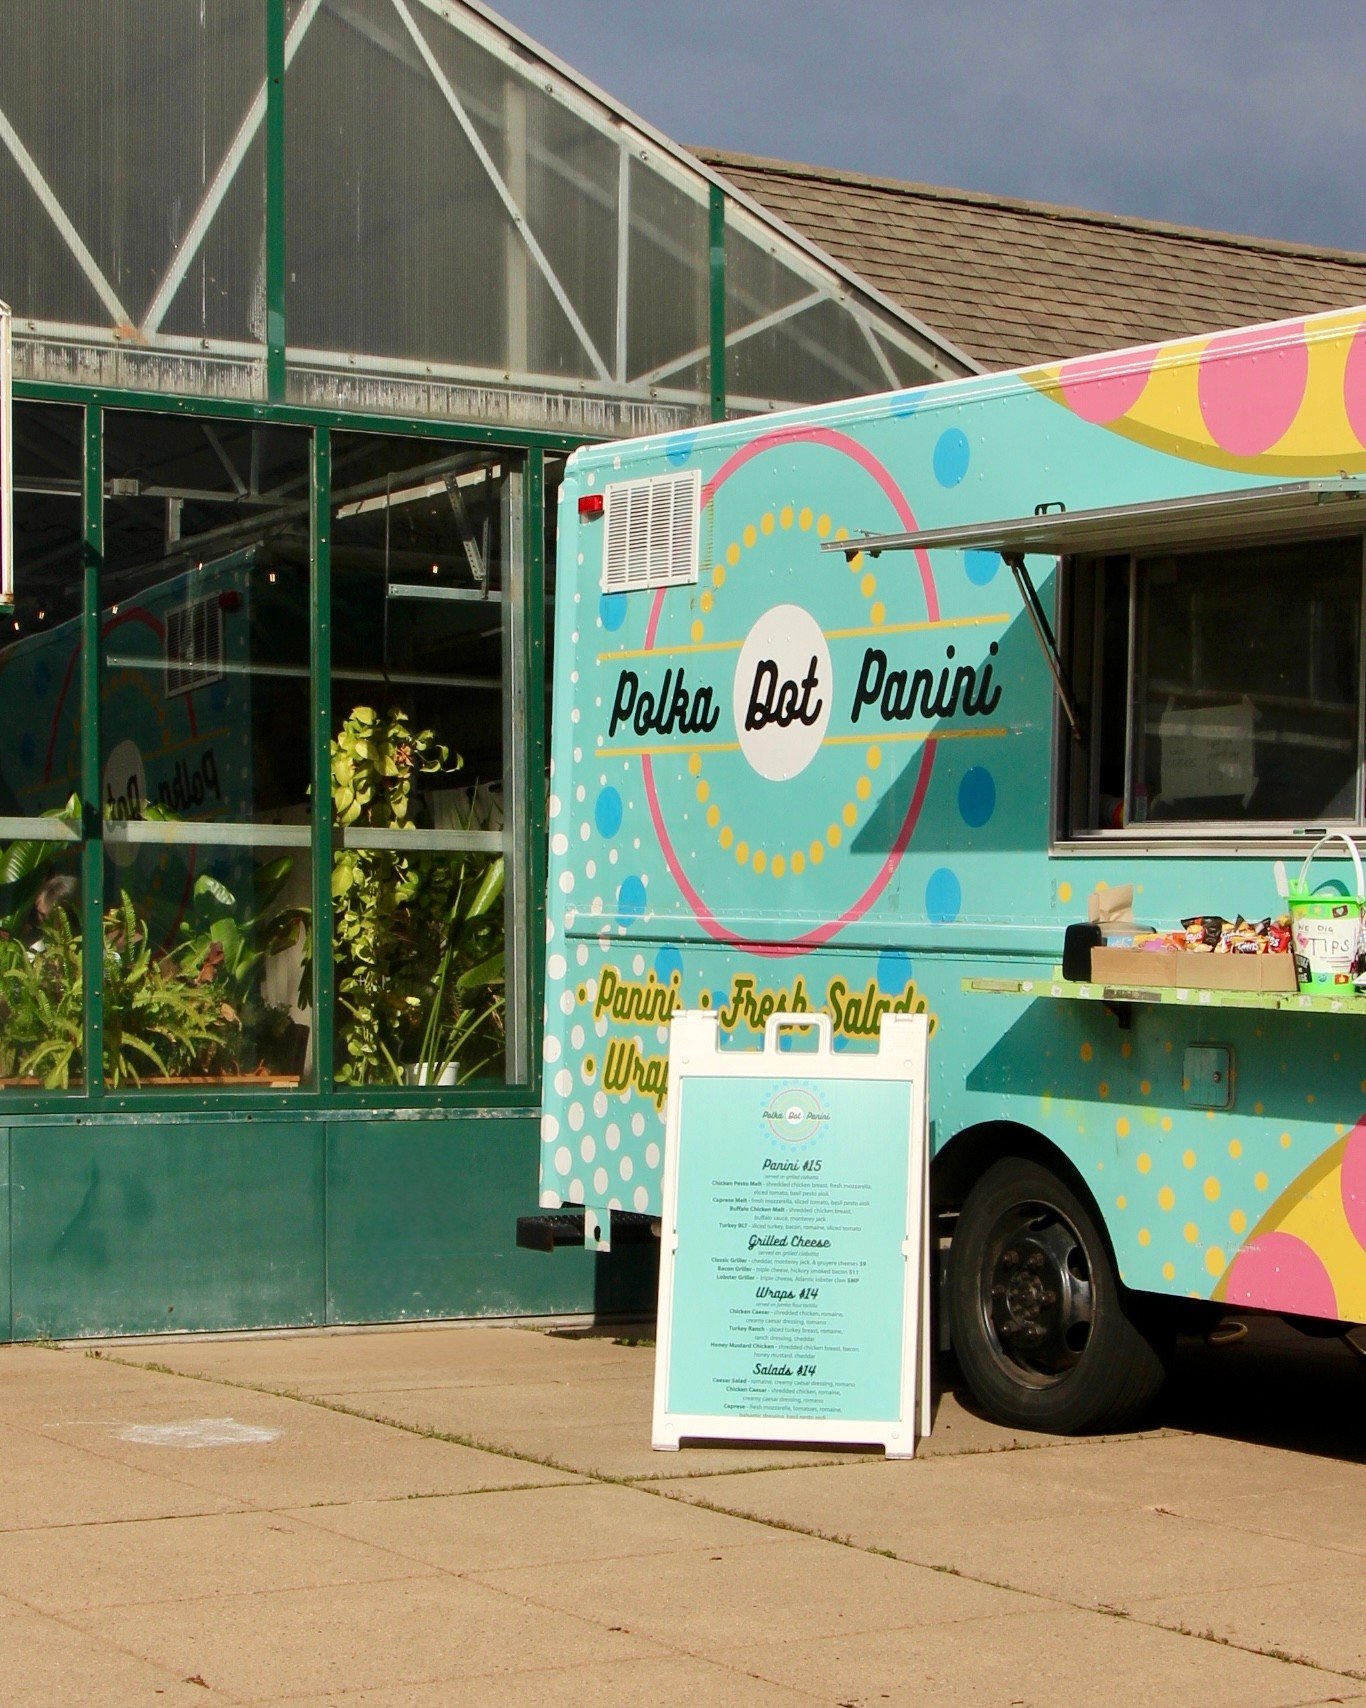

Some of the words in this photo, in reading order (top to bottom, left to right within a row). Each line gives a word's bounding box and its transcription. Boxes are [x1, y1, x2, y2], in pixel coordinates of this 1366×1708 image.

[609, 667, 720, 737] Polka
[745, 655, 823, 732] Dot
[851, 641, 1002, 723] Panini
[595, 969, 682, 1022] Panini
[762, 1110, 784, 1119] Polka
[788, 1111, 802, 1120] Dot
[806, 1112, 831, 1121] Panini
[762, 1158, 800, 1172] Panini
[802, 1159, 822, 1172] $15
[734, 1180, 749, 1188] Pesto
[750, 1180, 762, 1188] Melt
[766, 1180, 791, 1188] shredded
[790, 1216, 814, 1224] monterey
[814, 1216, 826, 1224] jack
[719, 1222, 737, 1230] Turkey
[748, 1234, 789, 1251] Grilled
[790, 1235, 832, 1248] Cheese
[711, 1256, 729, 1264] Classic
[774, 1259, 798, 1267] monterey
[815, 1276, 834, 1284] lobster
[756, 1286, 797, 1302] Wraps
[799, 1288, 819, 1300] $14
[752, 1308, 770, 1316] Caesar
[746, 1318, 764, 1326] creamy
[729, 1325, 748, 1333] Turkey
[710, 1342, 728, 1350] Honey
[752, 1342, 775, 1350] Chicken
[804, 1344, 824, 1352] chicken
[754, 1351, 771, 1359] honey
[794, 1352, 816, 1360] cheddar
[752, 1363, 794, 1376] Salads
[796, 1365, 817, 1377] $14
[712, 1376, 731, 1384] Caesar
[748, 1386, 767, 1394] Caesar
[724, 1402, 746, 1410] Caprese
